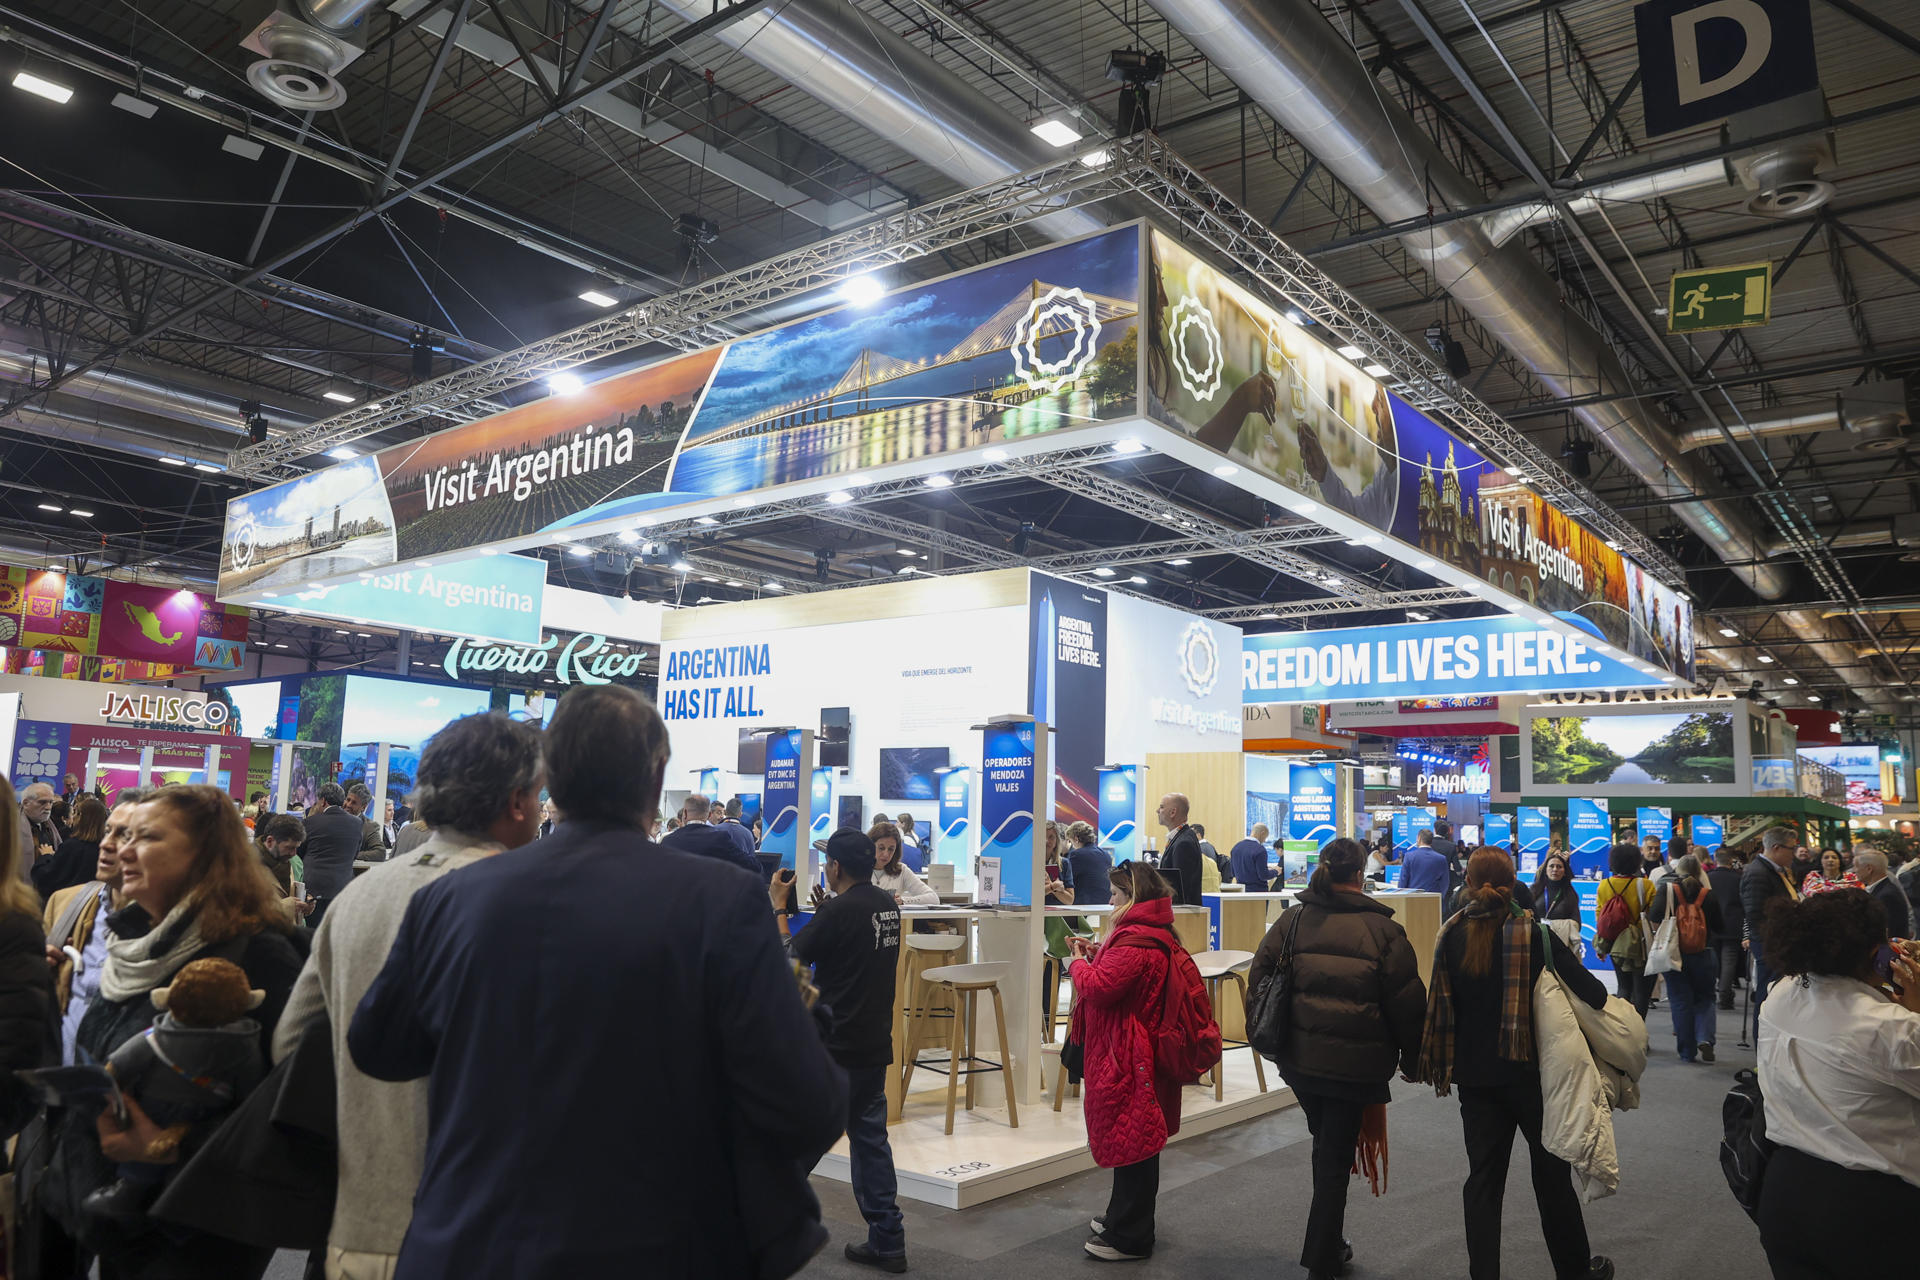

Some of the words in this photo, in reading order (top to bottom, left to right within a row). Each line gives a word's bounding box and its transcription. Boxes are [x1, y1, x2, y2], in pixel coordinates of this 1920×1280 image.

[1671, 0, 1772, 106] D
[424, 460, 479, 511] Visit
[483, 425, 634, 501] Argentina
[1487, 498, 1520, 556] Visit
[1523, 523, 1584, 592] Argentina
[418, 572, 534, 613] Argentina
[1059, 615, 1094, 635] ARGENTINA.
[1059, 628, 1093, 651] FREEDOM
[443, 633, 558, 680] Puerto
[556, 633, 648, 686] Rico
[666, 643, 771, 681] ARGENTINA
[1058, 644, 1080, 664] LIVES
[1080, 648, 1101, 668] HERE.
[1242, 642, 1370, 690] REEDOM
[1377, 635, 1480, 684] LIVES
[1487, 630, 1602, 678] HERE.
[100, 691, 228, 725] JALISCO
[664, 688, 700, 720] HAS
[703, 687, 722, 719] IT
[724, 685, 764, 718] ALL.
[1243, 706, 1271, 721] IDA
[90, 737, 129, 747] JALISCO
[1021, 730, 1031, 741] 18
[768, 770, 777, 779] EVT
[778, 770, 788, 778] DMC
[789, 769, 796, 778] DE
[984, 757, 1032, 768] OPERADORES
[768, 781, 795, 790] ARGENTINA
[990, 770, 1025, 780] MENDOZA
[995, 783, 1019, 792] VIAJES
[936, 1161, 991, 1177] 3C08
